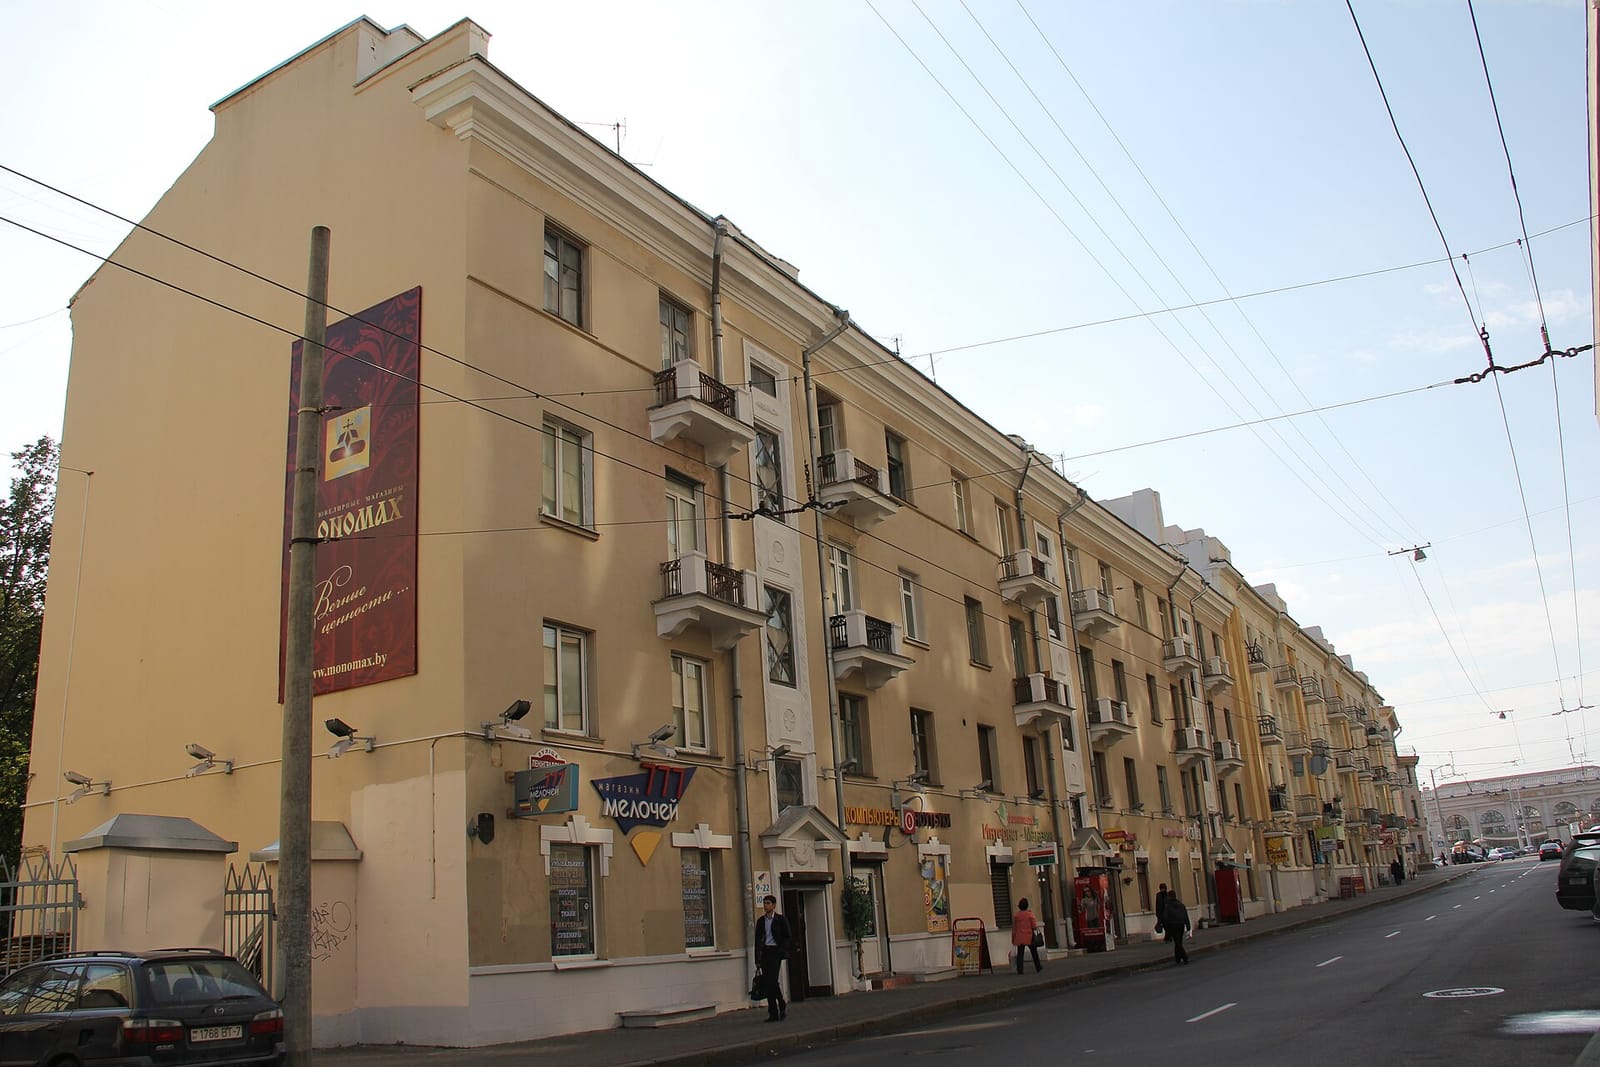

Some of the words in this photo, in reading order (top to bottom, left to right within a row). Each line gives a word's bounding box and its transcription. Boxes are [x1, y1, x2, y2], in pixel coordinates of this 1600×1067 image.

[317, 495, 404, 539] ОНОМАХ
[640, 762, 684, 800] 777
[199, 1028, 219, 1040] 1768
[221, 1026, 241, 1038] BT-7
